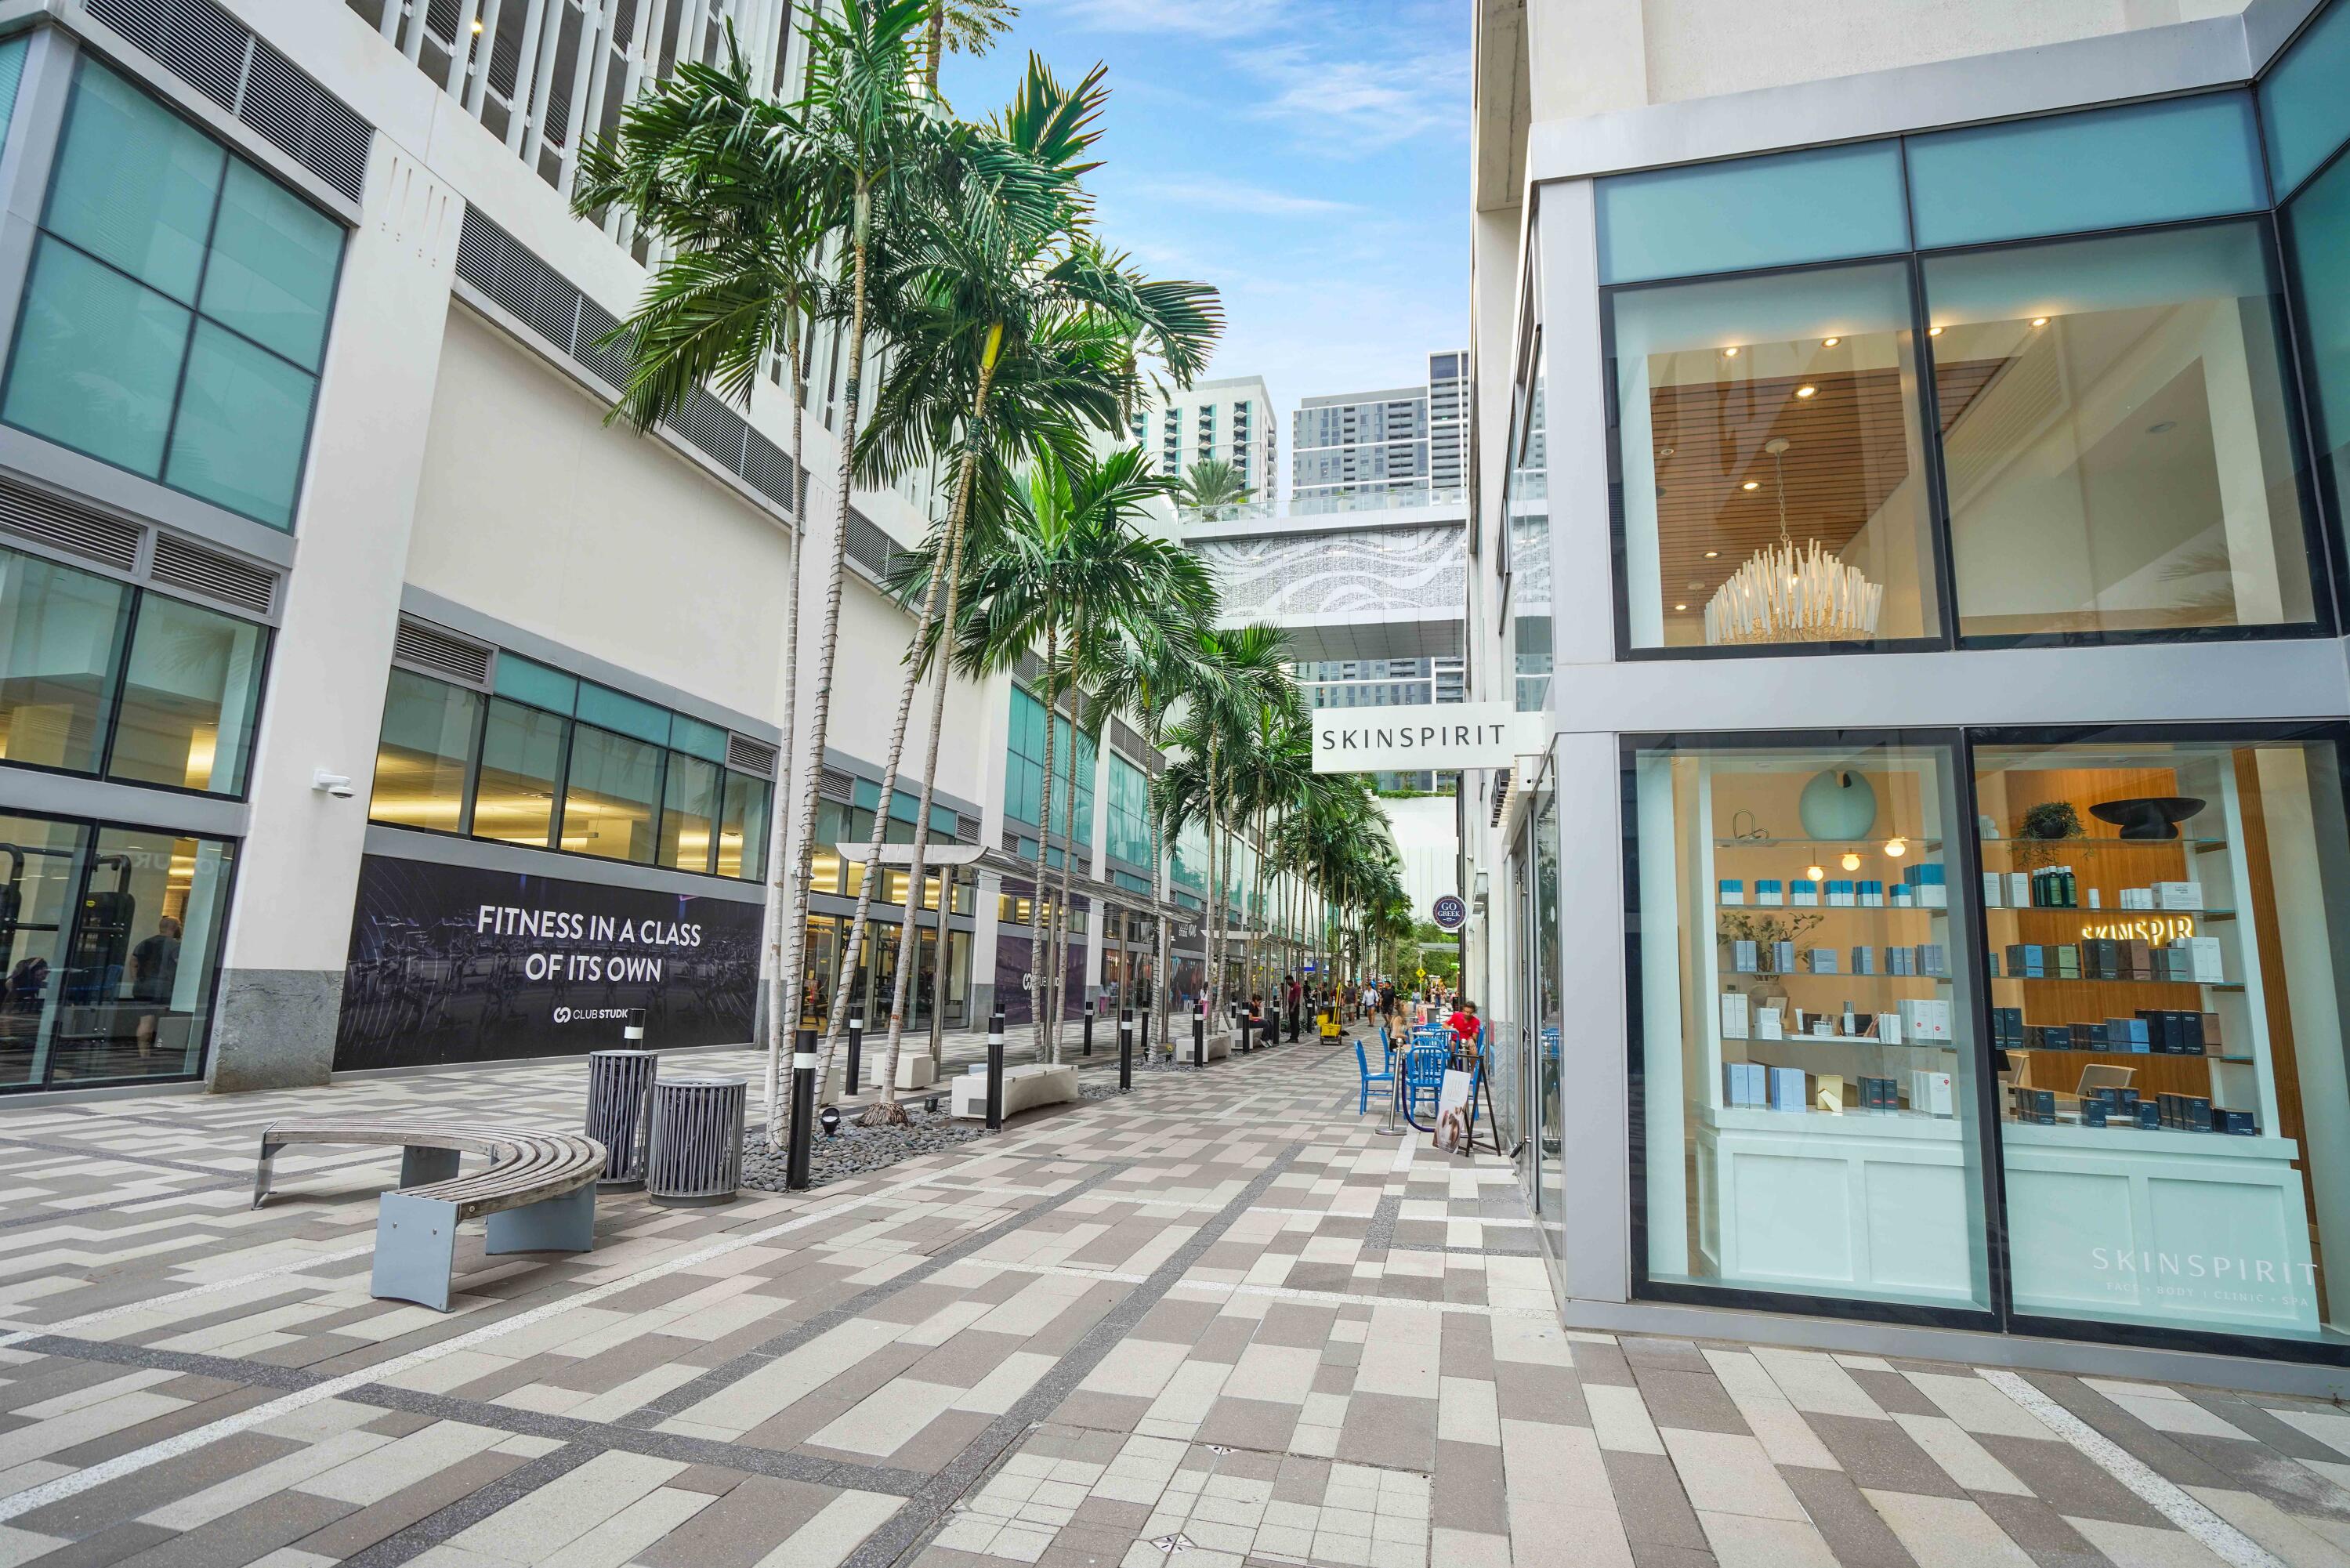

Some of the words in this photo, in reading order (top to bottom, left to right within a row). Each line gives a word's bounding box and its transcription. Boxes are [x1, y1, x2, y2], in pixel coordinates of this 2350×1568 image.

[1322, 724, 1505, 750] SKINSPIRIT
[1441, 902, 1457, 911] GO
[477, 904, 585, 940] FITNESS
[589, 915, 615, 942] IN
[618, 918, 635, 943] A
[640, 920, 701, 947] CLASS
[2081, 917, 2192, 946] SKINSPIR
[525, 953, 563, 980] OF
[568, 955, 603, 981] ITS
[607, 957, 661, 983] OWN
[573, 1009, 598, 1019] CLUB
[2092, 1248, 2318, 1286] SKINSPIRIT
[2106, 1281, 2139, 1293] FACE
[2156, 1286, 2195, 1298] BODY
[2214, 1291, 2265, 1303] CLINIC
[2281, 1295, 2309, 1307] SPA
